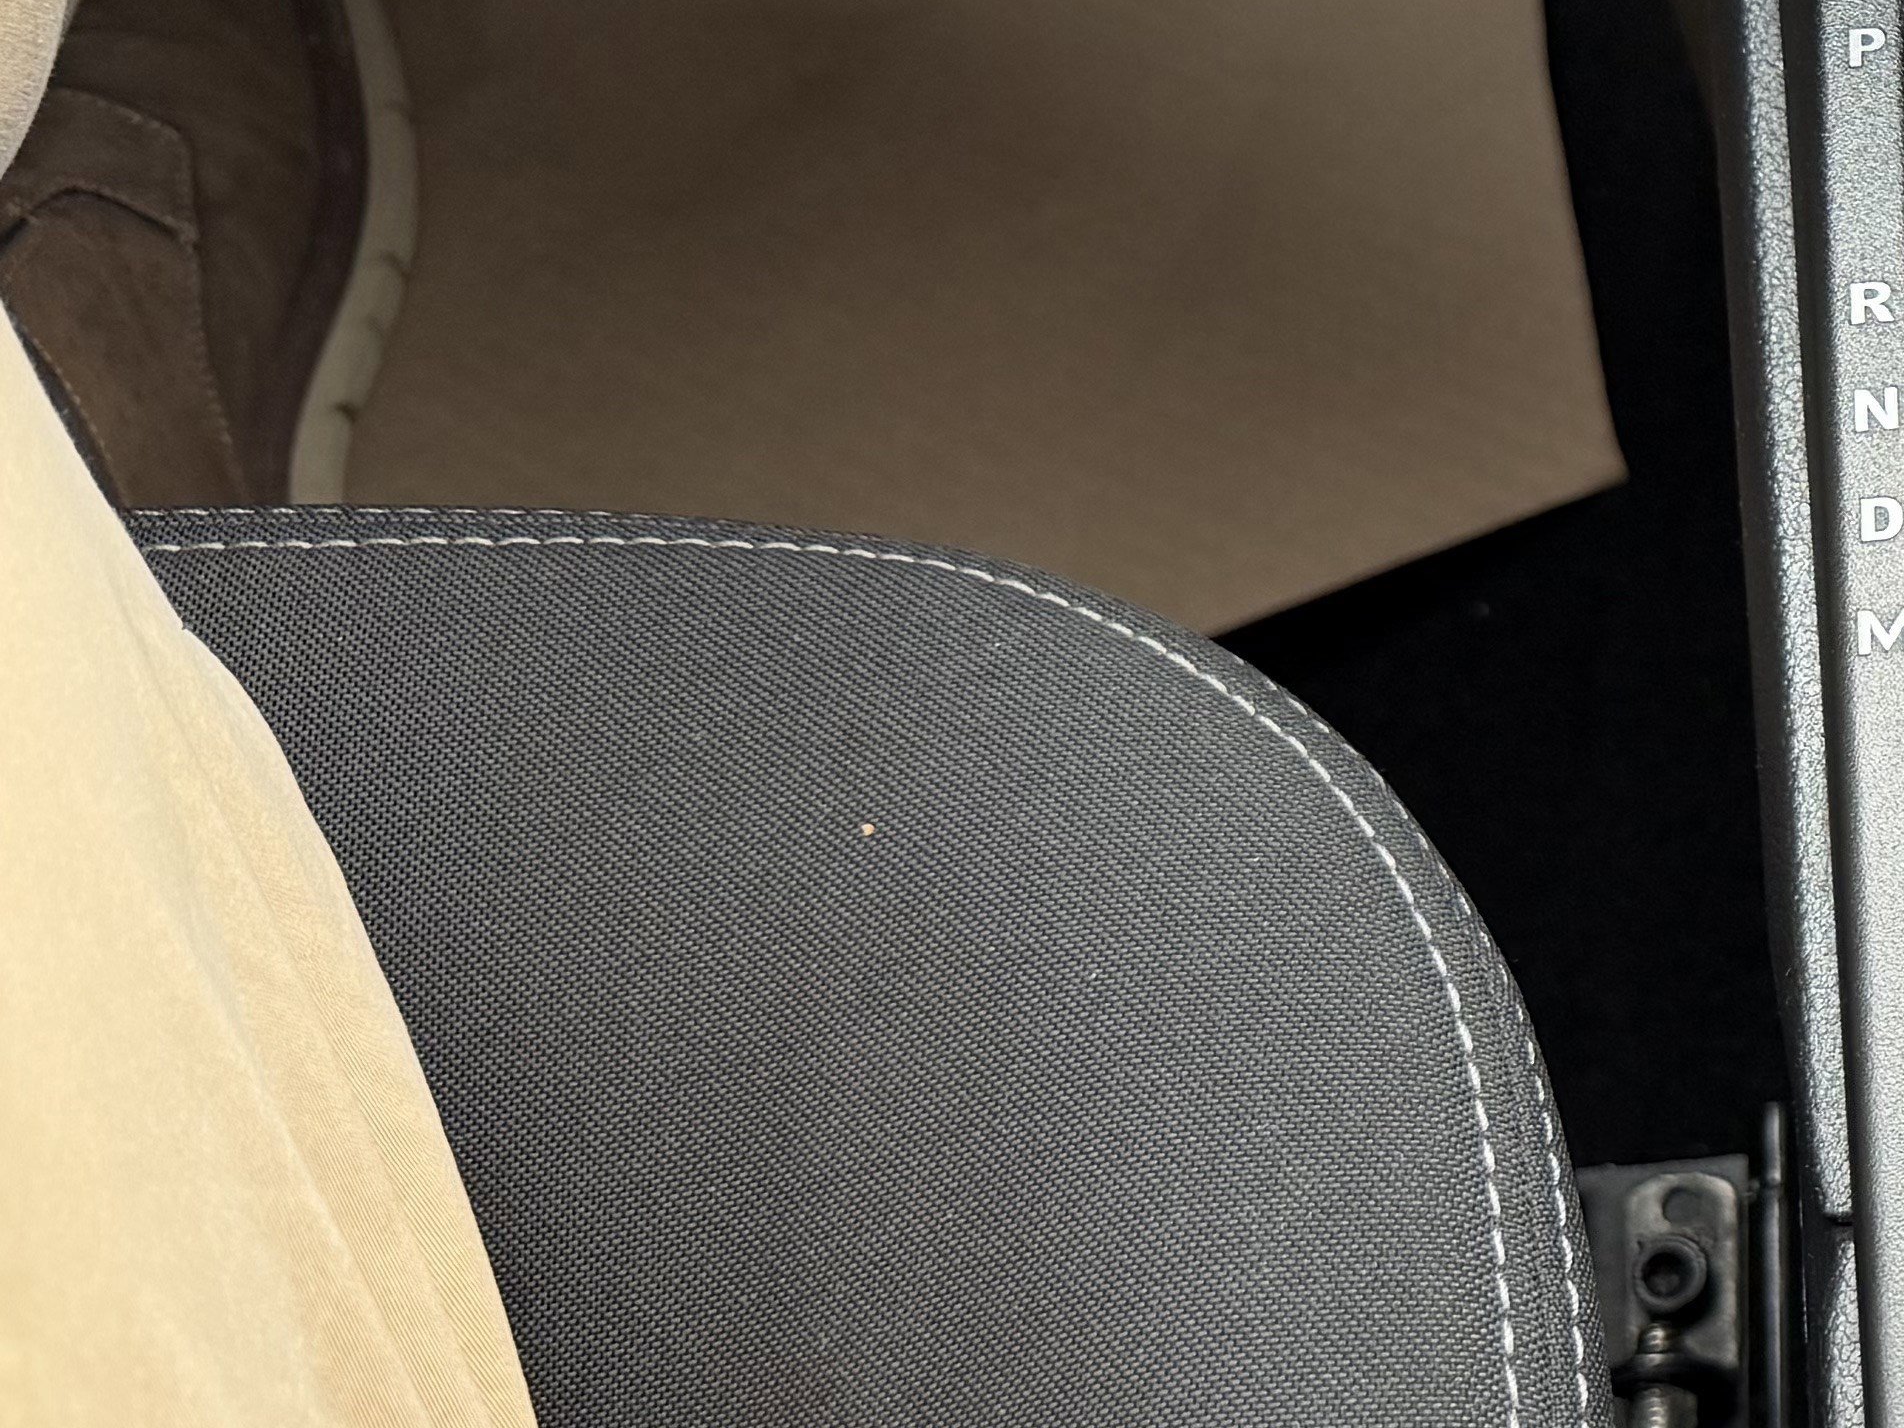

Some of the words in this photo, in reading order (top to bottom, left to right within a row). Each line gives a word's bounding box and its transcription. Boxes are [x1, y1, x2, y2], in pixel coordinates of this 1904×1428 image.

[1848, 27, 1886, 67] P
[1849, 280, 1895, 325] R
[1853, 385, 1900, 433] N
[1859, 496, 1904, 543] D
